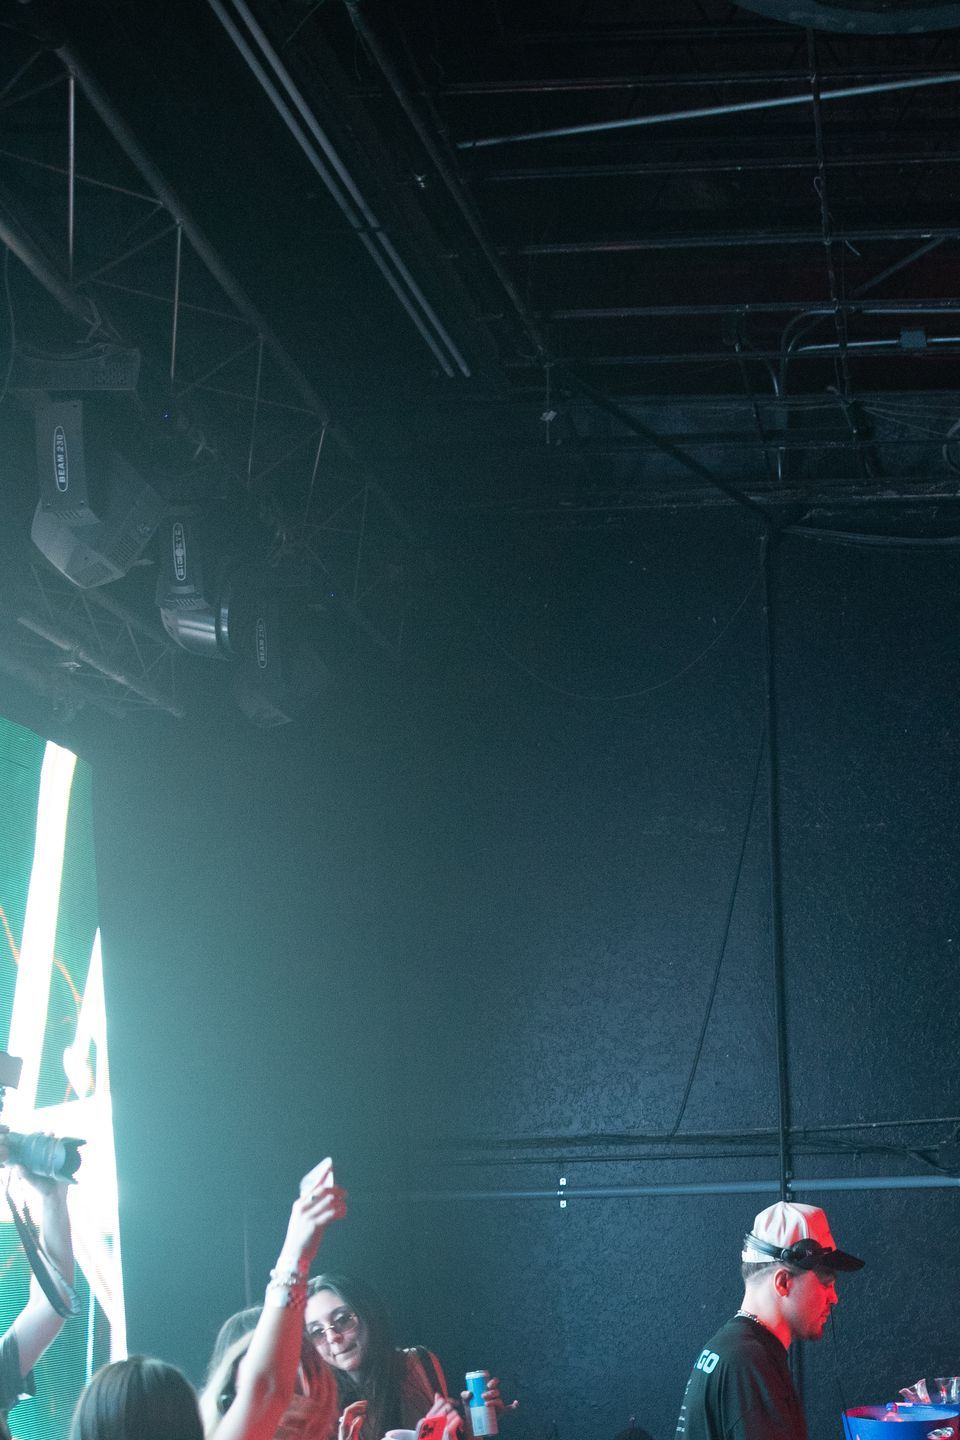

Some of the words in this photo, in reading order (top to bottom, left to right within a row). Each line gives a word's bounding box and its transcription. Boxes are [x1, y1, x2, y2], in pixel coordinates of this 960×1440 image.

[56, 434, 64, 452] 230
[57, 454, 66, 483] BEAM
[694, 1349, 720, 1374] GO
